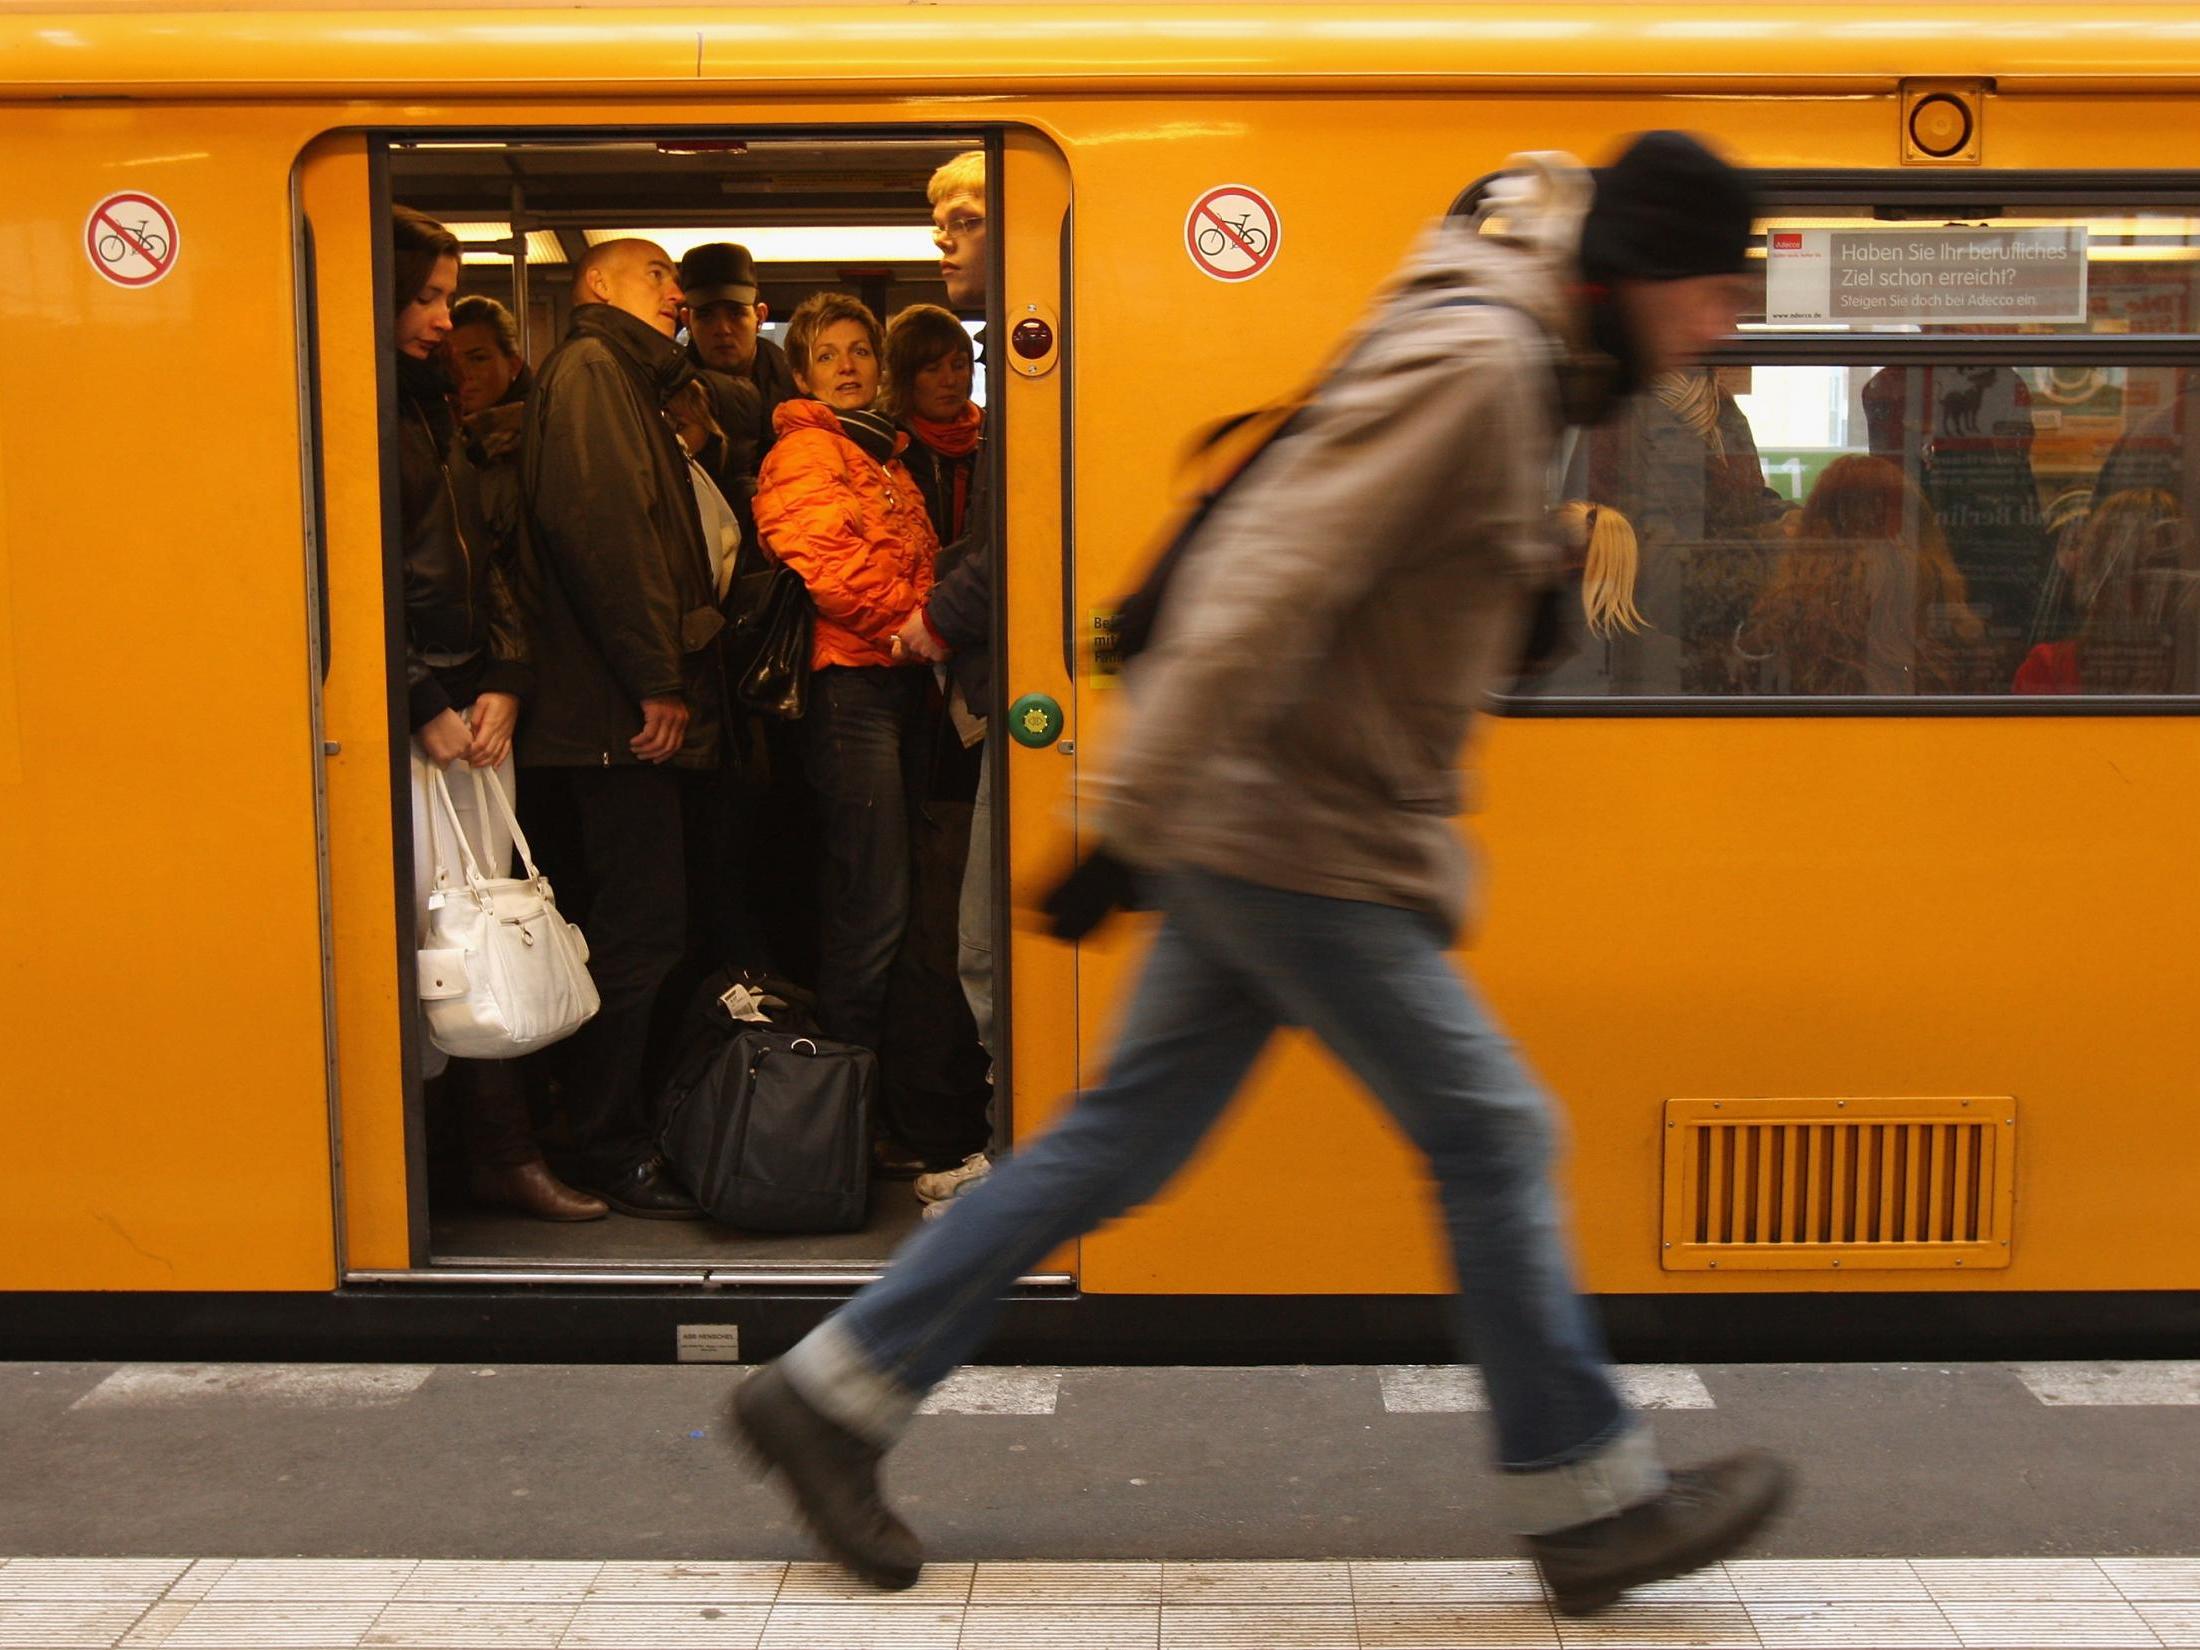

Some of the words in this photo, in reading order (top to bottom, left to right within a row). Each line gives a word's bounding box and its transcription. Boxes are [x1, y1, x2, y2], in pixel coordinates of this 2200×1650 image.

[1841, 243, 1903, 261] Haben
[1908, 243, 1935, 261] Sie
[1940, 241, 1964, 261] Ihr
[1969, 241, 2067, 260] berufliches
[1841, 268, 1873, 287] Ziel
[1879, 268, 1933, 287] schon
[1938, 267, 2017, 287] erreicht?
[1840, 294, 1887, 310] Steigen
[1890, 294, 1908, 307] Sie
[1911, 293, 1942, 307] doch
[1945, 293, 1965, 306] bei
[1967, 293, 2014, 306] Adecco
